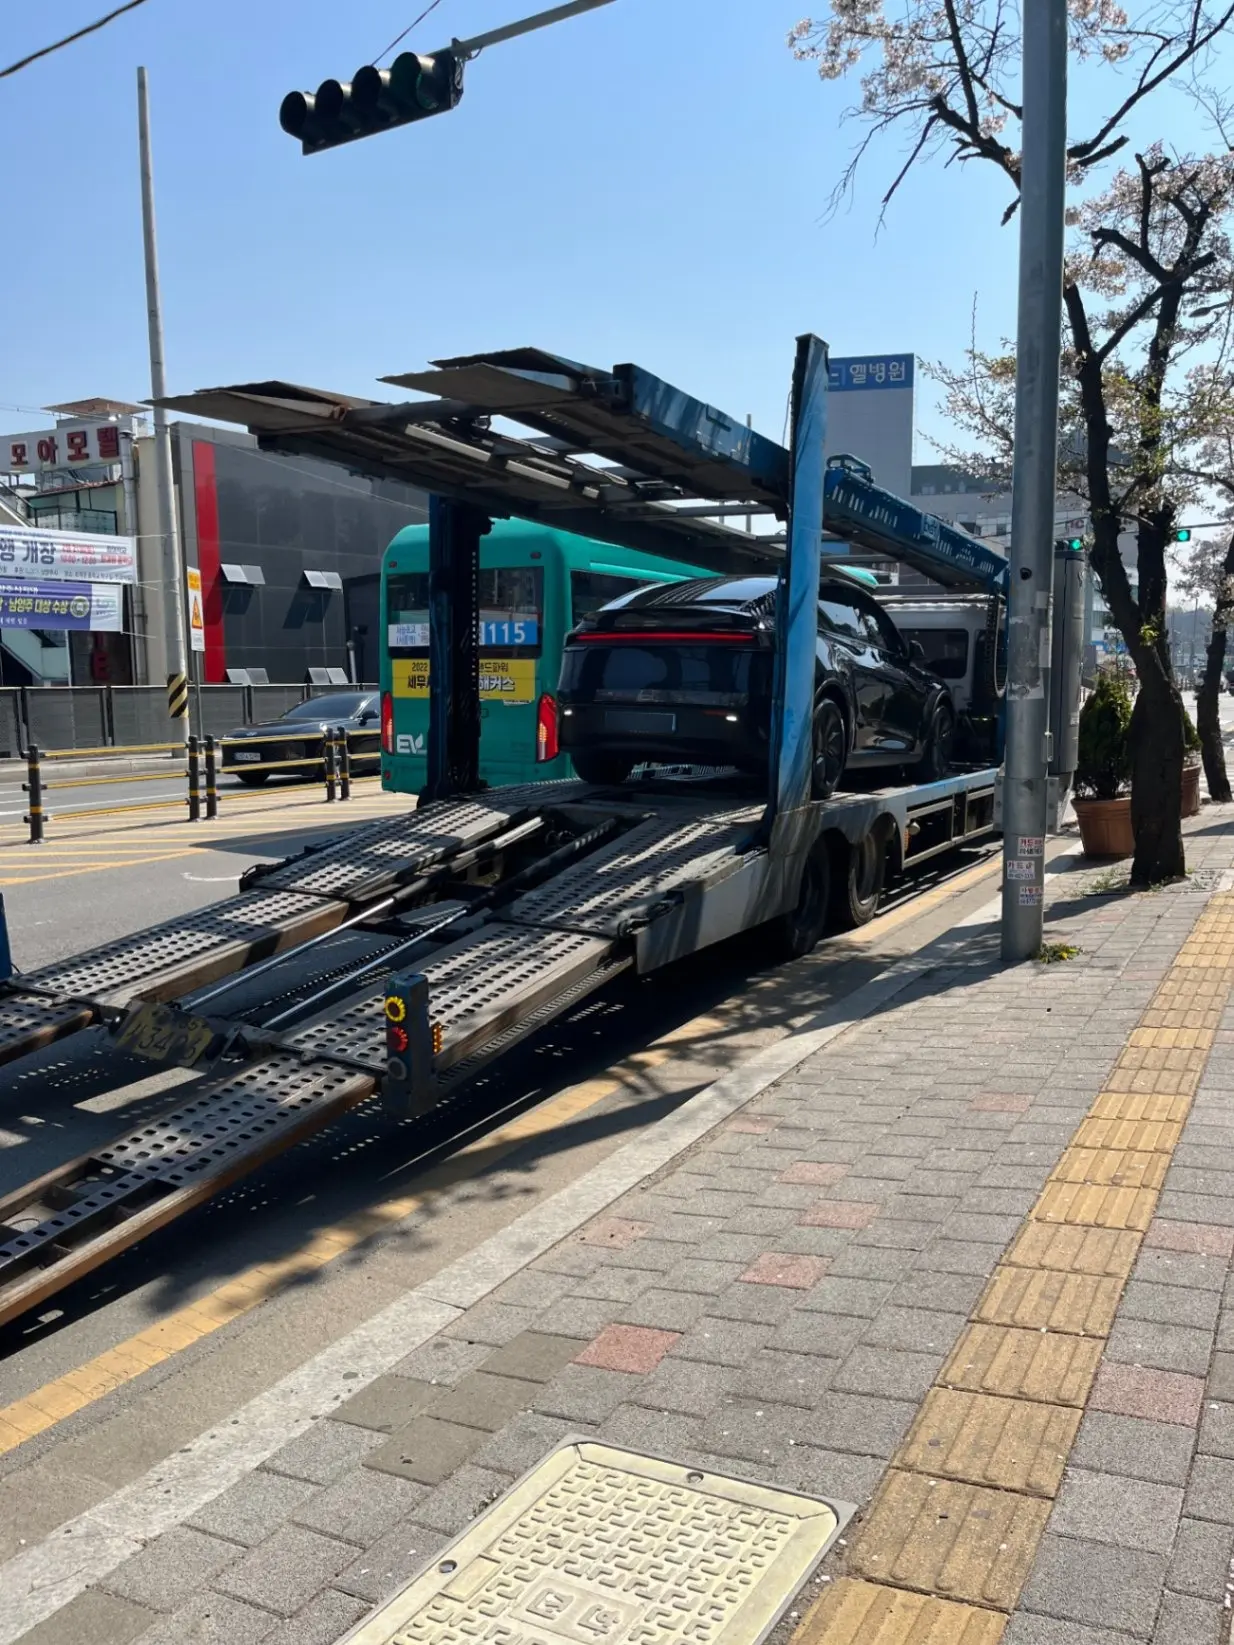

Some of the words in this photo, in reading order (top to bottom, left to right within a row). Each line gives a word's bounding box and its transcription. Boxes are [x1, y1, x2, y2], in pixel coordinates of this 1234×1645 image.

[11, 426, 119, 466] 모아모텔
[22, 539, 57, 565] 개장
[34, 598, 52, 614] 대상
[52, 599, 69, 615] 수상
[488, 622, 526, 644] 115
[411, 662, 428, 672] 2022
[407, 674, 431, 690] 세무
[397, 733, 423, 754] EV
